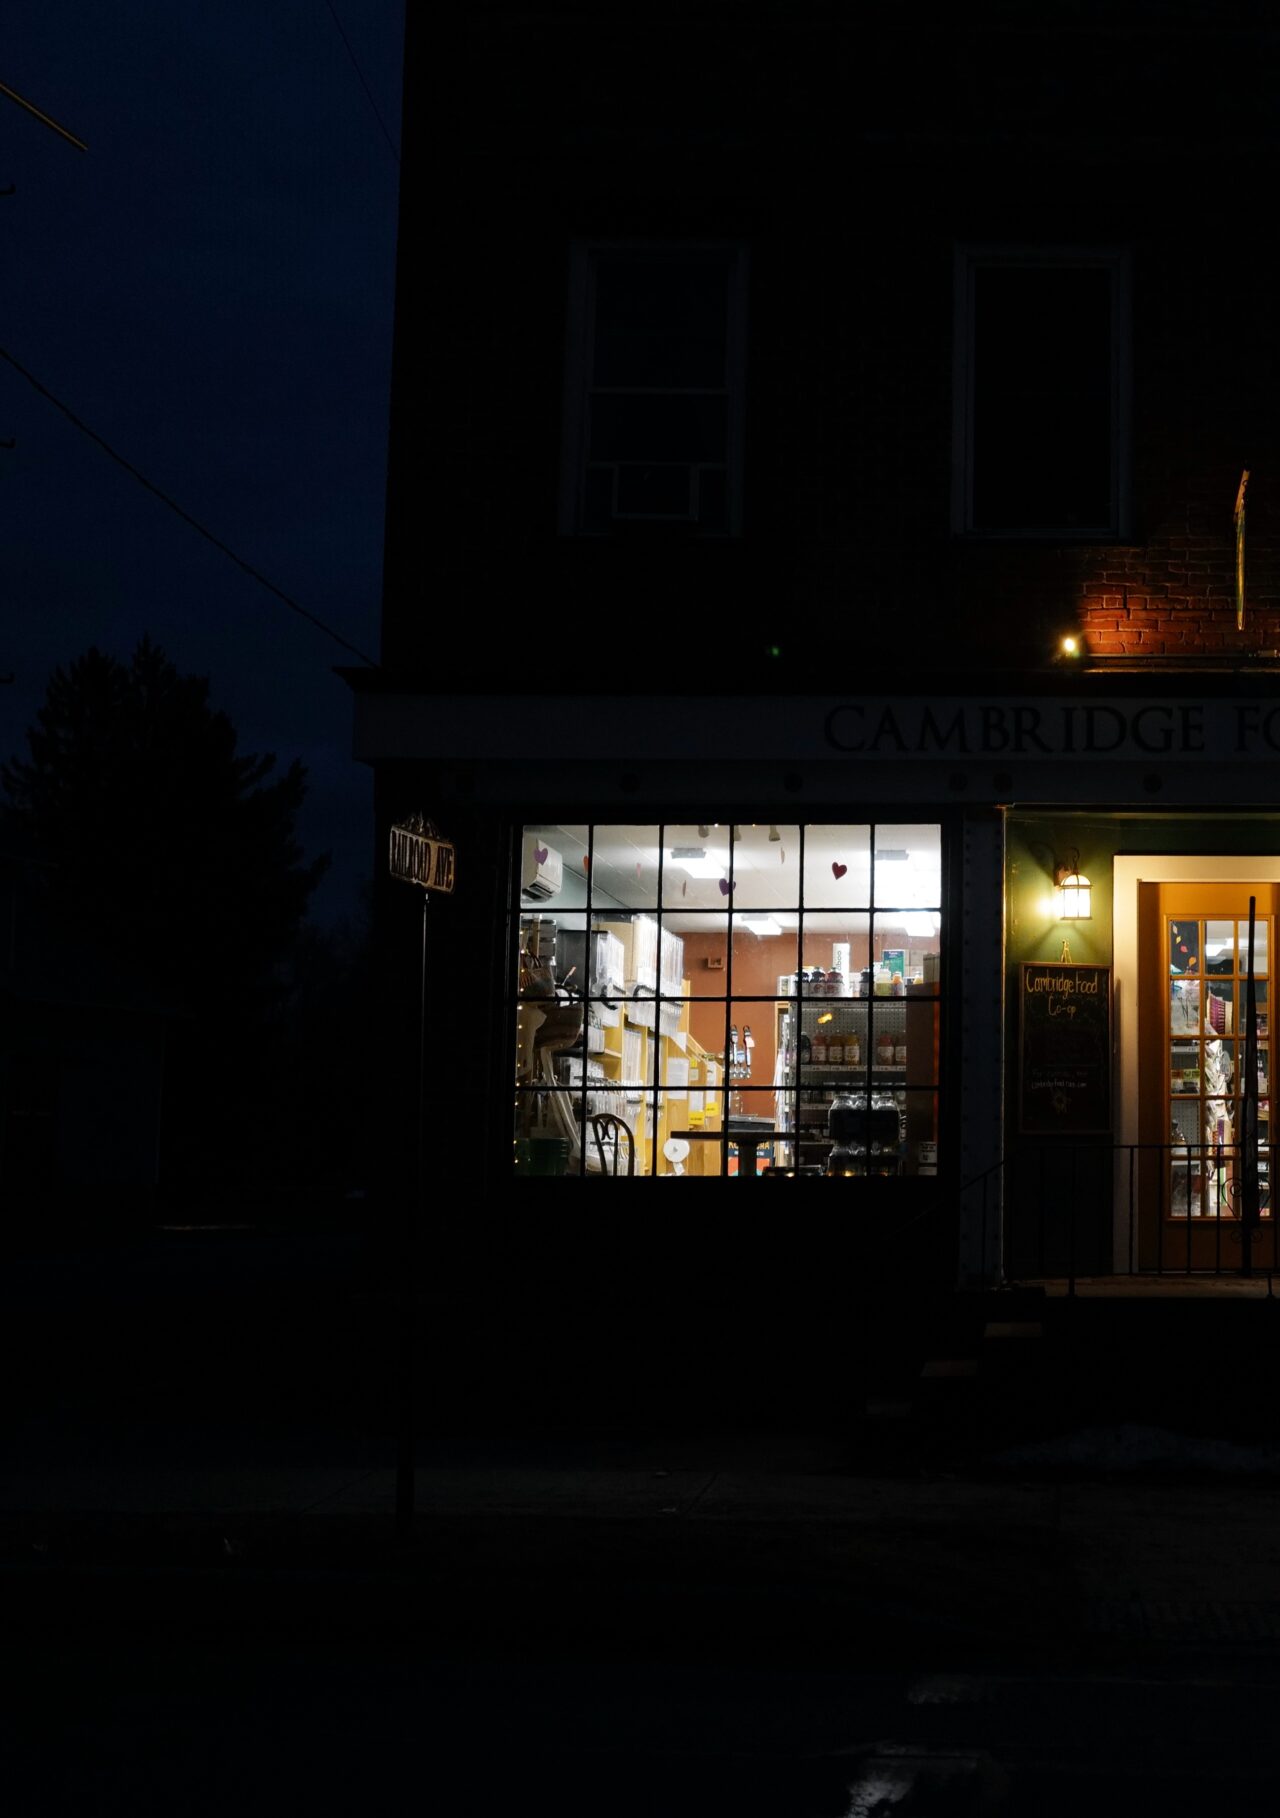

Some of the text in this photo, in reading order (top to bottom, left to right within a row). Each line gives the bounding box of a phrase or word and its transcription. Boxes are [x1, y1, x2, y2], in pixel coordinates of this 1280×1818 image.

[823, 703, 1206, 754] CAMBRIDGE
[391, 829, 454, 890] RAILROAD AVE
[1026, 968, 1098, 1001] Cambridge Food
[1047, 995, 1077, 1020] Co-op
